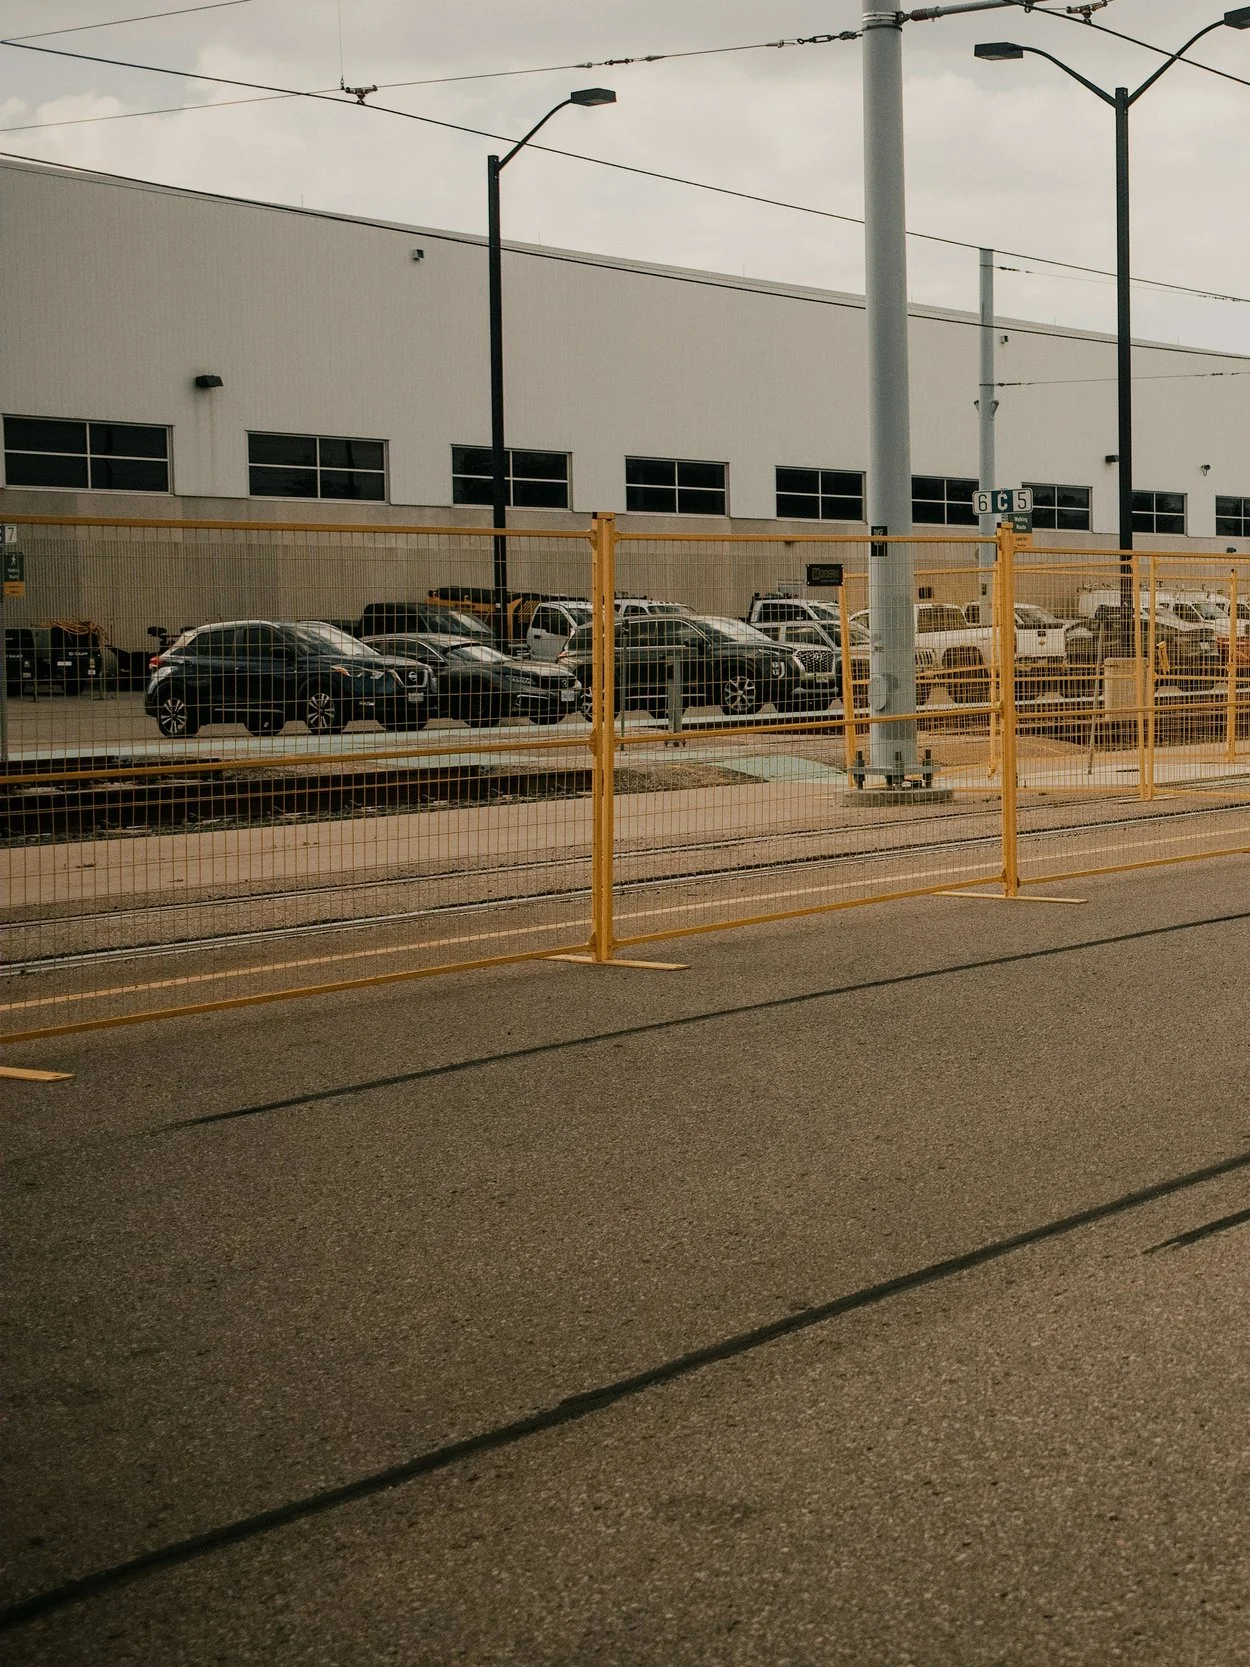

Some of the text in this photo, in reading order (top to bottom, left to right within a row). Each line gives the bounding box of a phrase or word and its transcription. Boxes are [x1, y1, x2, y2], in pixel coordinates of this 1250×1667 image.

[978, 492, 1027, 511] 6 C 5
[7, 527, 15, 541] 7
